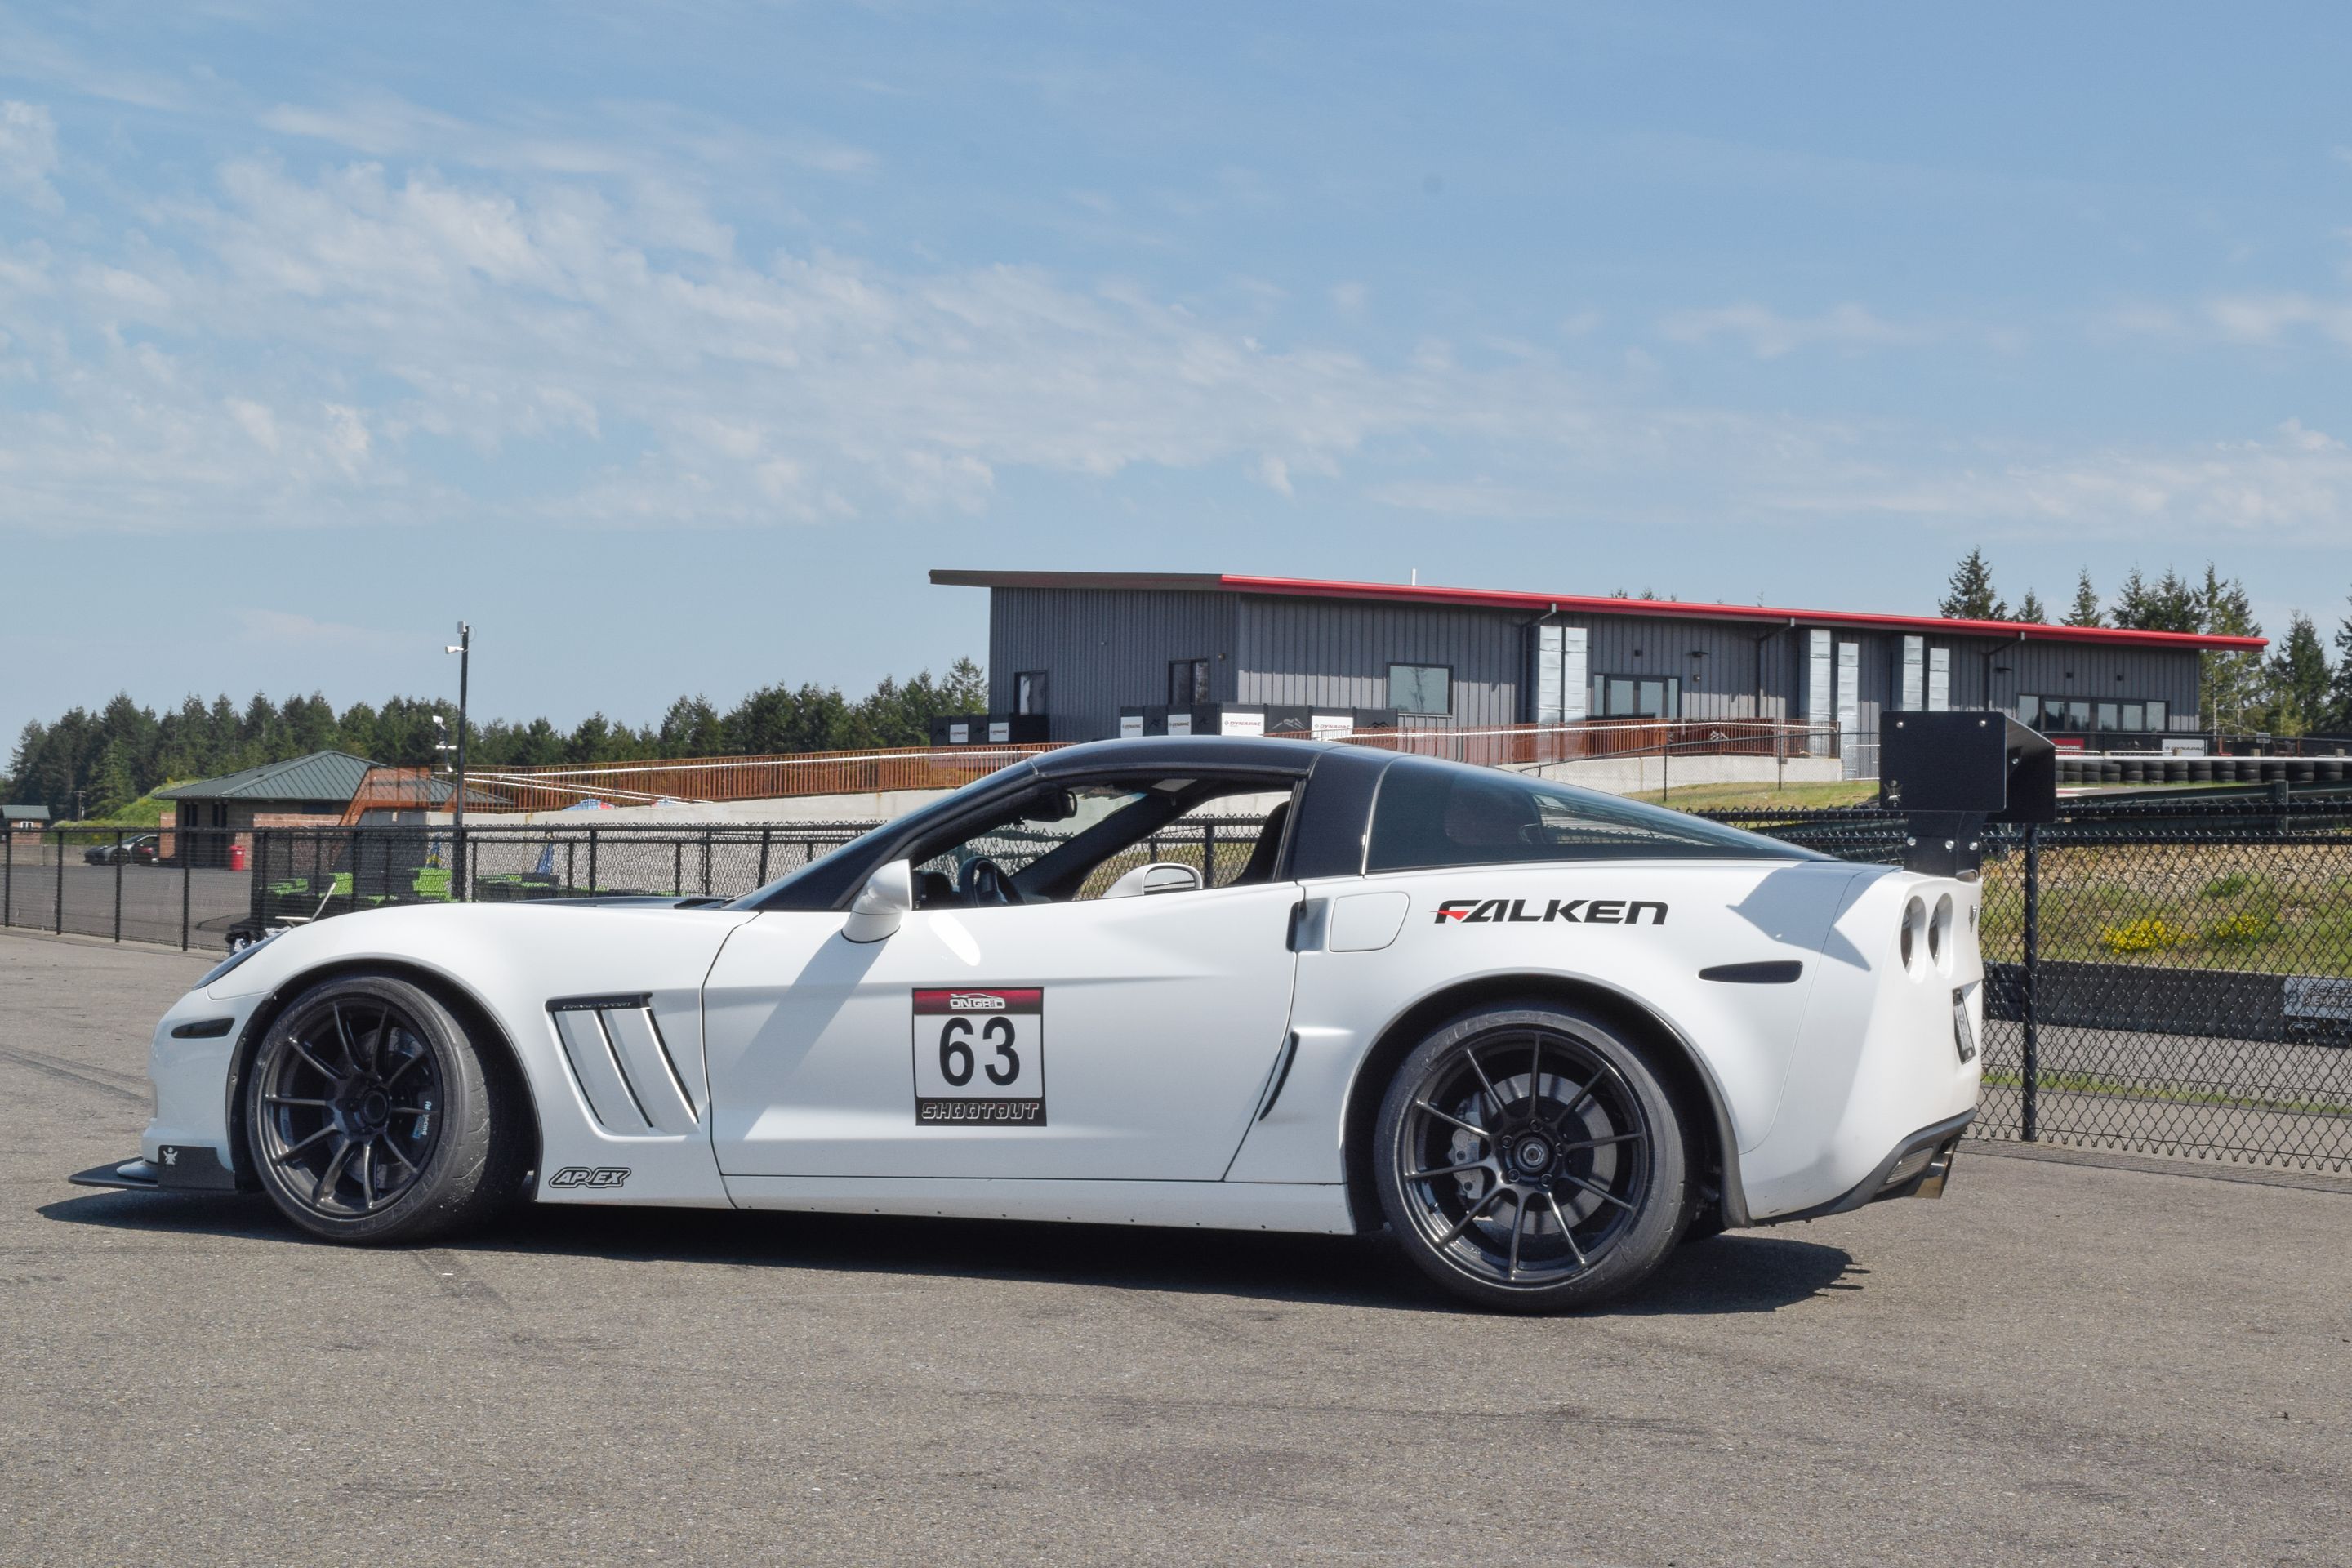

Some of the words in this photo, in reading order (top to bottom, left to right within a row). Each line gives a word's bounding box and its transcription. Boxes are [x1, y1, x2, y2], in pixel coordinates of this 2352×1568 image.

[1432, 899, 1668, 924] FALKEN
[940, 1017, 1020, 1086] 63
[921, 1102, 1039, 1120] SHOOTOUT
[550, 1169, 629, 1187] APEX
